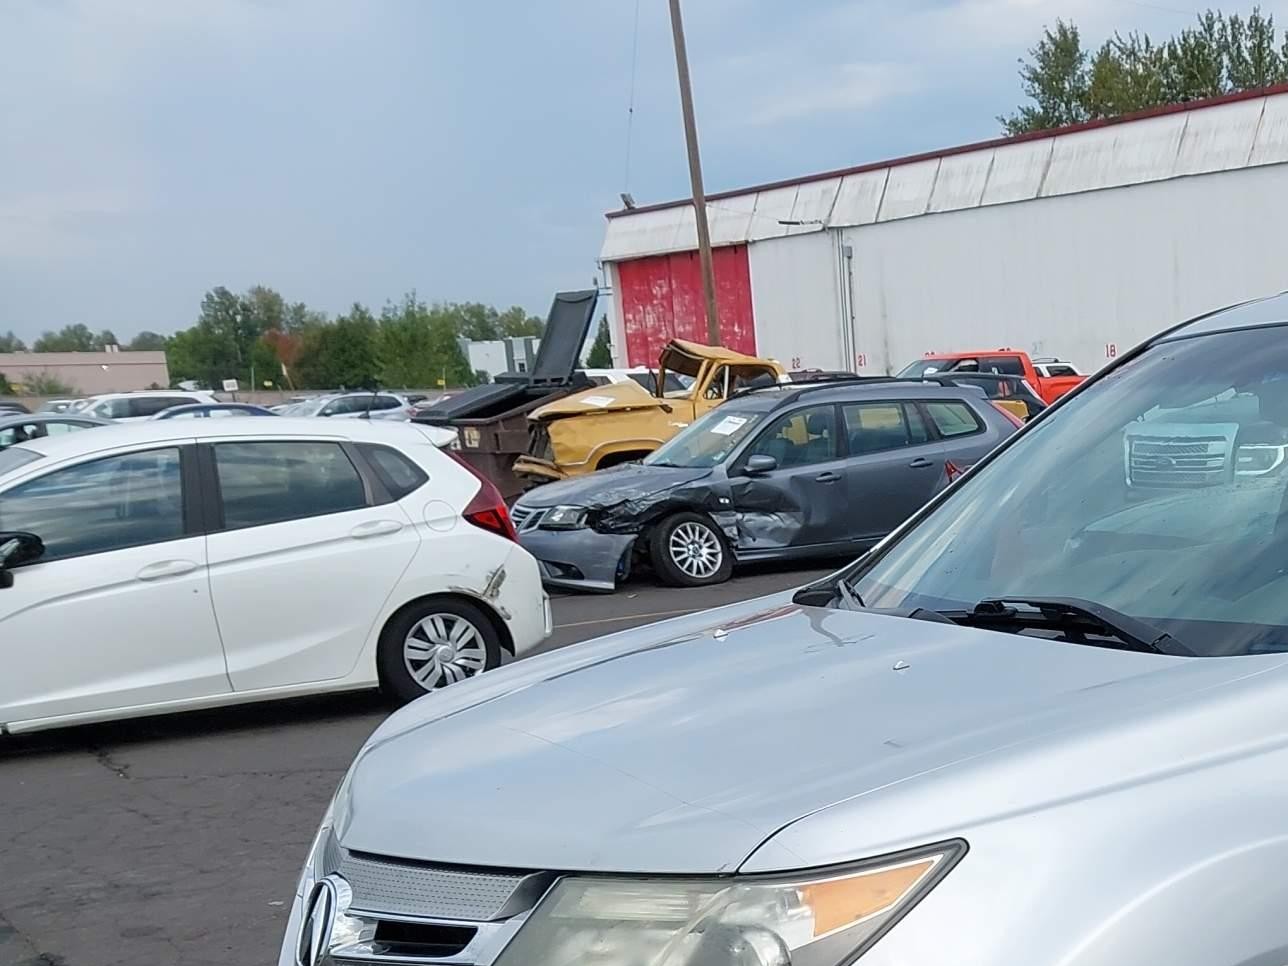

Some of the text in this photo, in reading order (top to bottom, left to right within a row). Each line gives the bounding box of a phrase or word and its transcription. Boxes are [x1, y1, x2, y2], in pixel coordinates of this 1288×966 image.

[1106, 344, 1117, 358] 18
[792, 356, 801, 369] 22
[858, 353, 867, 367] 21
